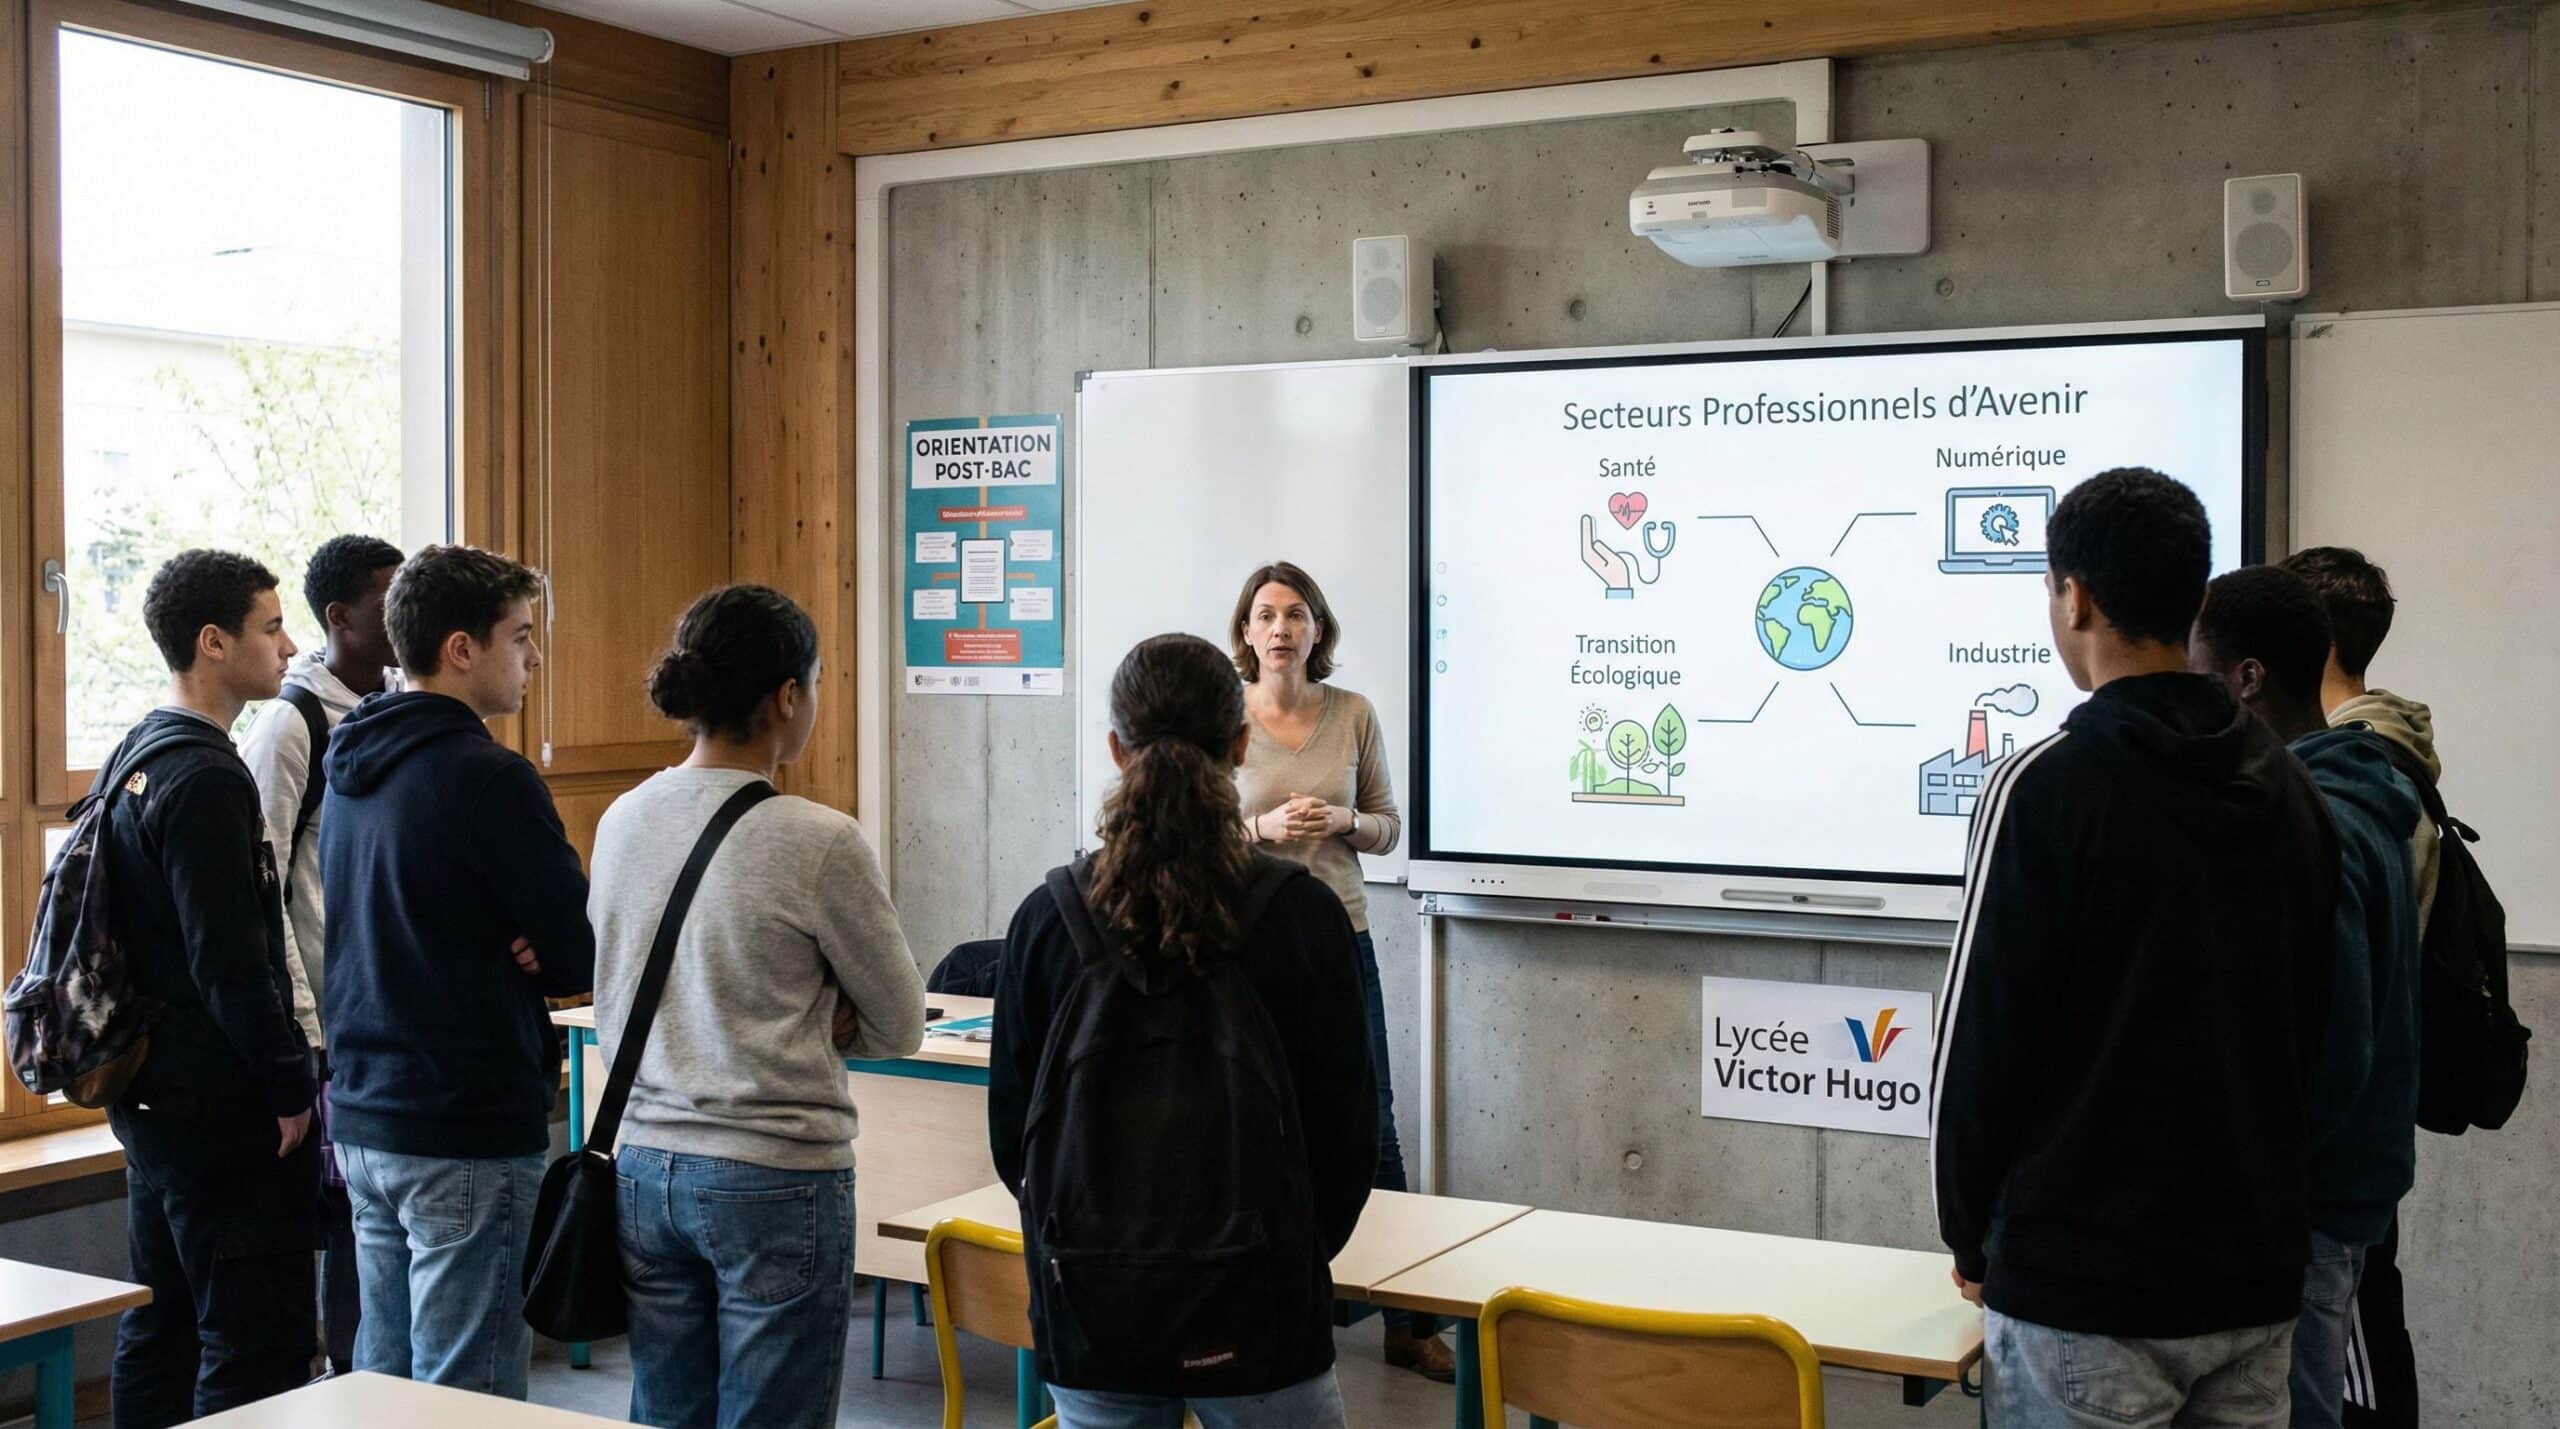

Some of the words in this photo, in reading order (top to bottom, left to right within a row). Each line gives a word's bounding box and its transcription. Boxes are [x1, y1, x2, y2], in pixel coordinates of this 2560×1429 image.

[1563, 402, 1692, 431] Secteurs
[1703, 388, 1937, 426] Professionnels
[915, 434, 1051, 457] ORIENTATION
[1936, 444, 2066, 471] Numérique
[1598, 455, 1656, 478] Santé
[1575, 634, 1676, 654] Transition
[1948, 641, 2051, 664] Industrie
[1570, 659, 1681, 690] Écologique
[1715, 1016, 1809, 1057] Lycée
[1713, 1057, 1817, 1096] Victor
[1826, 1067, 1921, 1112] Hugo
